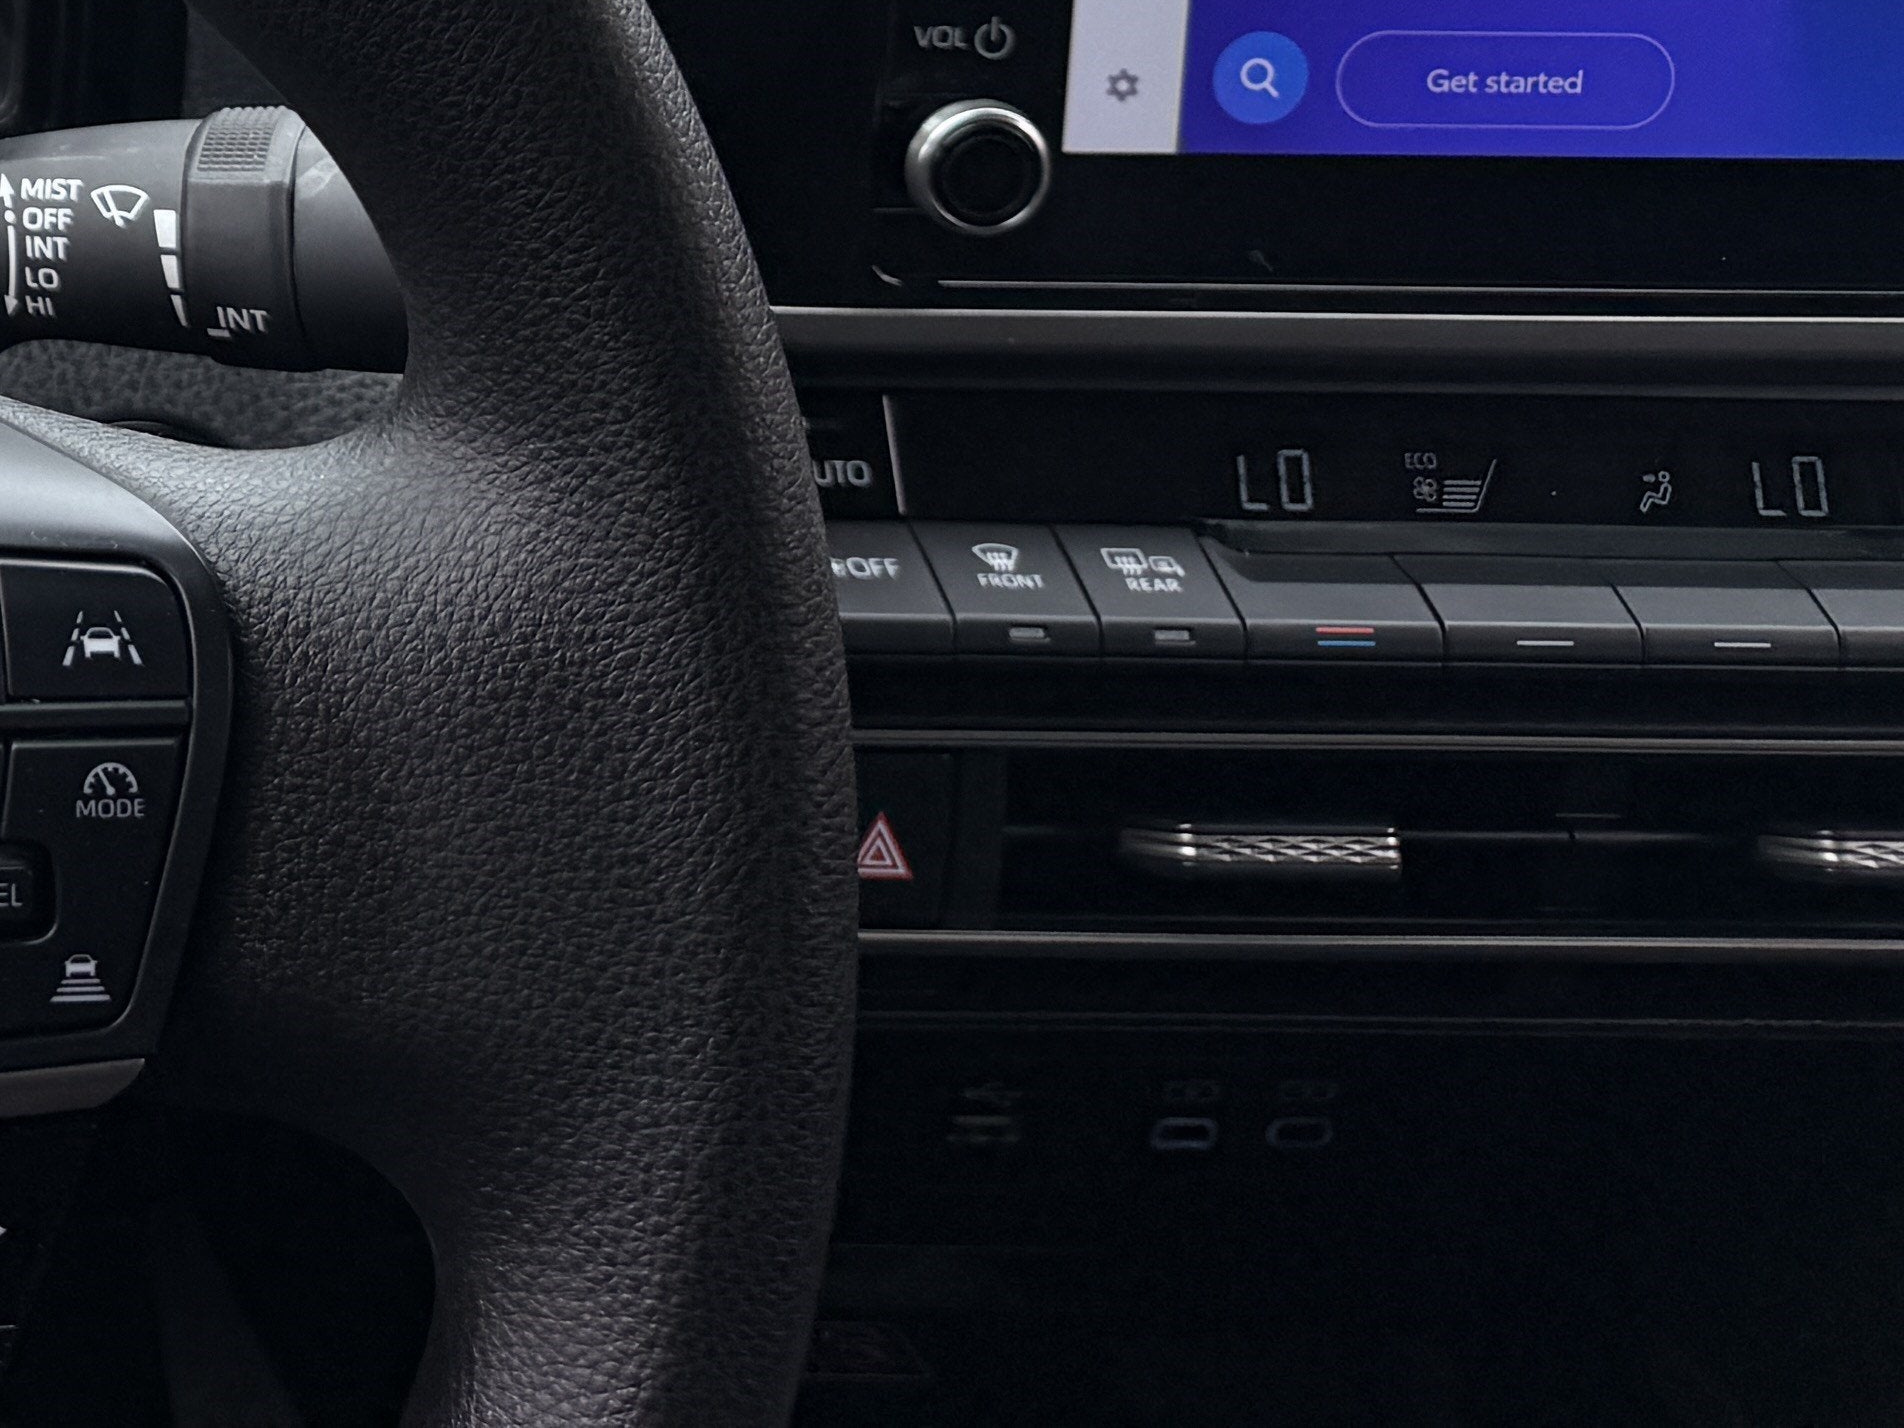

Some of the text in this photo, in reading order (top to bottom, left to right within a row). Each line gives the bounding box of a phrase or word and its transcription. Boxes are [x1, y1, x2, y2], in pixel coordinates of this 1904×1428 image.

[913, 25, 969, 50] VOL
[1426, 68, 1584, 94] Get started
[20, 178, 84, 202] MIST
[22, 206, 74, 231] OFF
[25, 235, 70, 261] INT
[25, 266, 60, 290] LO
[25, 296, 56, 317] HI
[216, 306, 269, 333] INT
[1404, 452, 1437, 469] ECO
[811, 460, 873, 488] UTO
[846, 557, 900, 580] OFF
[977, 573, 1045, 590] FRONT
[1126, 578, 1184, 594] REAR
[75, 798, 145, 819] MODE
